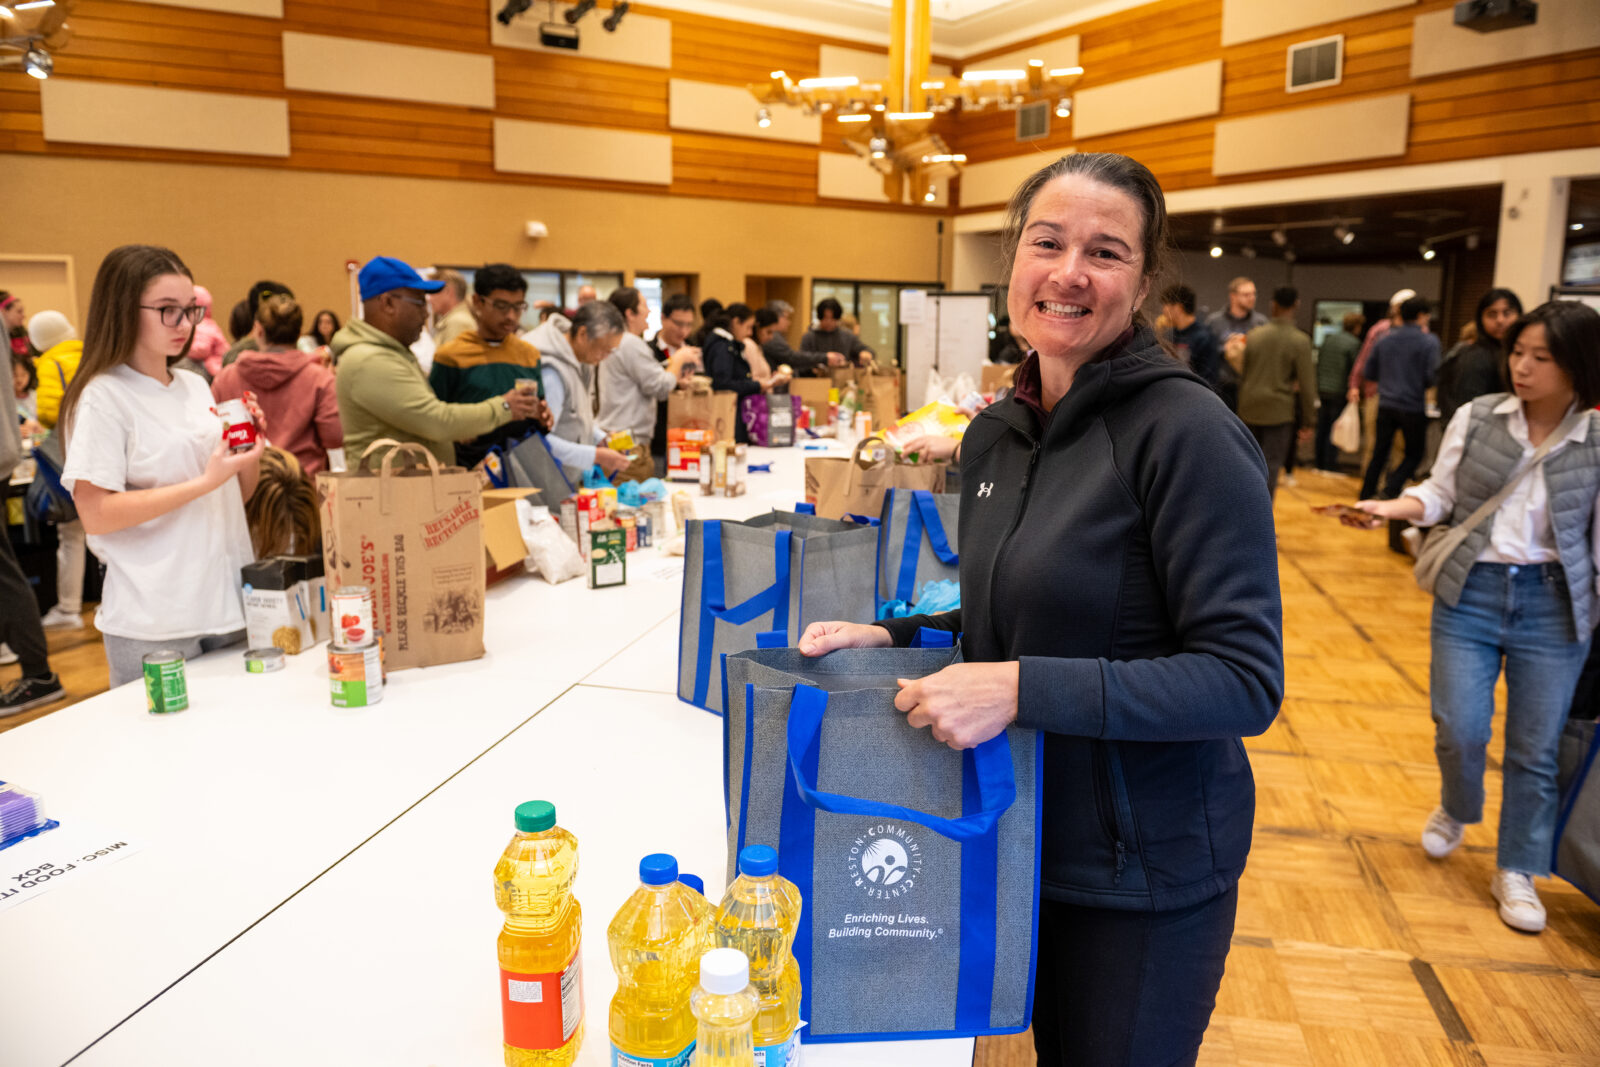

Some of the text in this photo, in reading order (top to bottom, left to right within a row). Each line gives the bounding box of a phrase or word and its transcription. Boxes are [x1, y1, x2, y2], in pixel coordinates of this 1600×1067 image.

[848, 824, 923, 899] RESTON COMMUNITY CENTER
[11, 863, 55, 881] BOX
[21, 863, 76, 888] FOOD
[0, 888, 19, 900] IT
[844, 913, 929, 925] Enriching Lives.
[828, 926, 872, 938] Building
